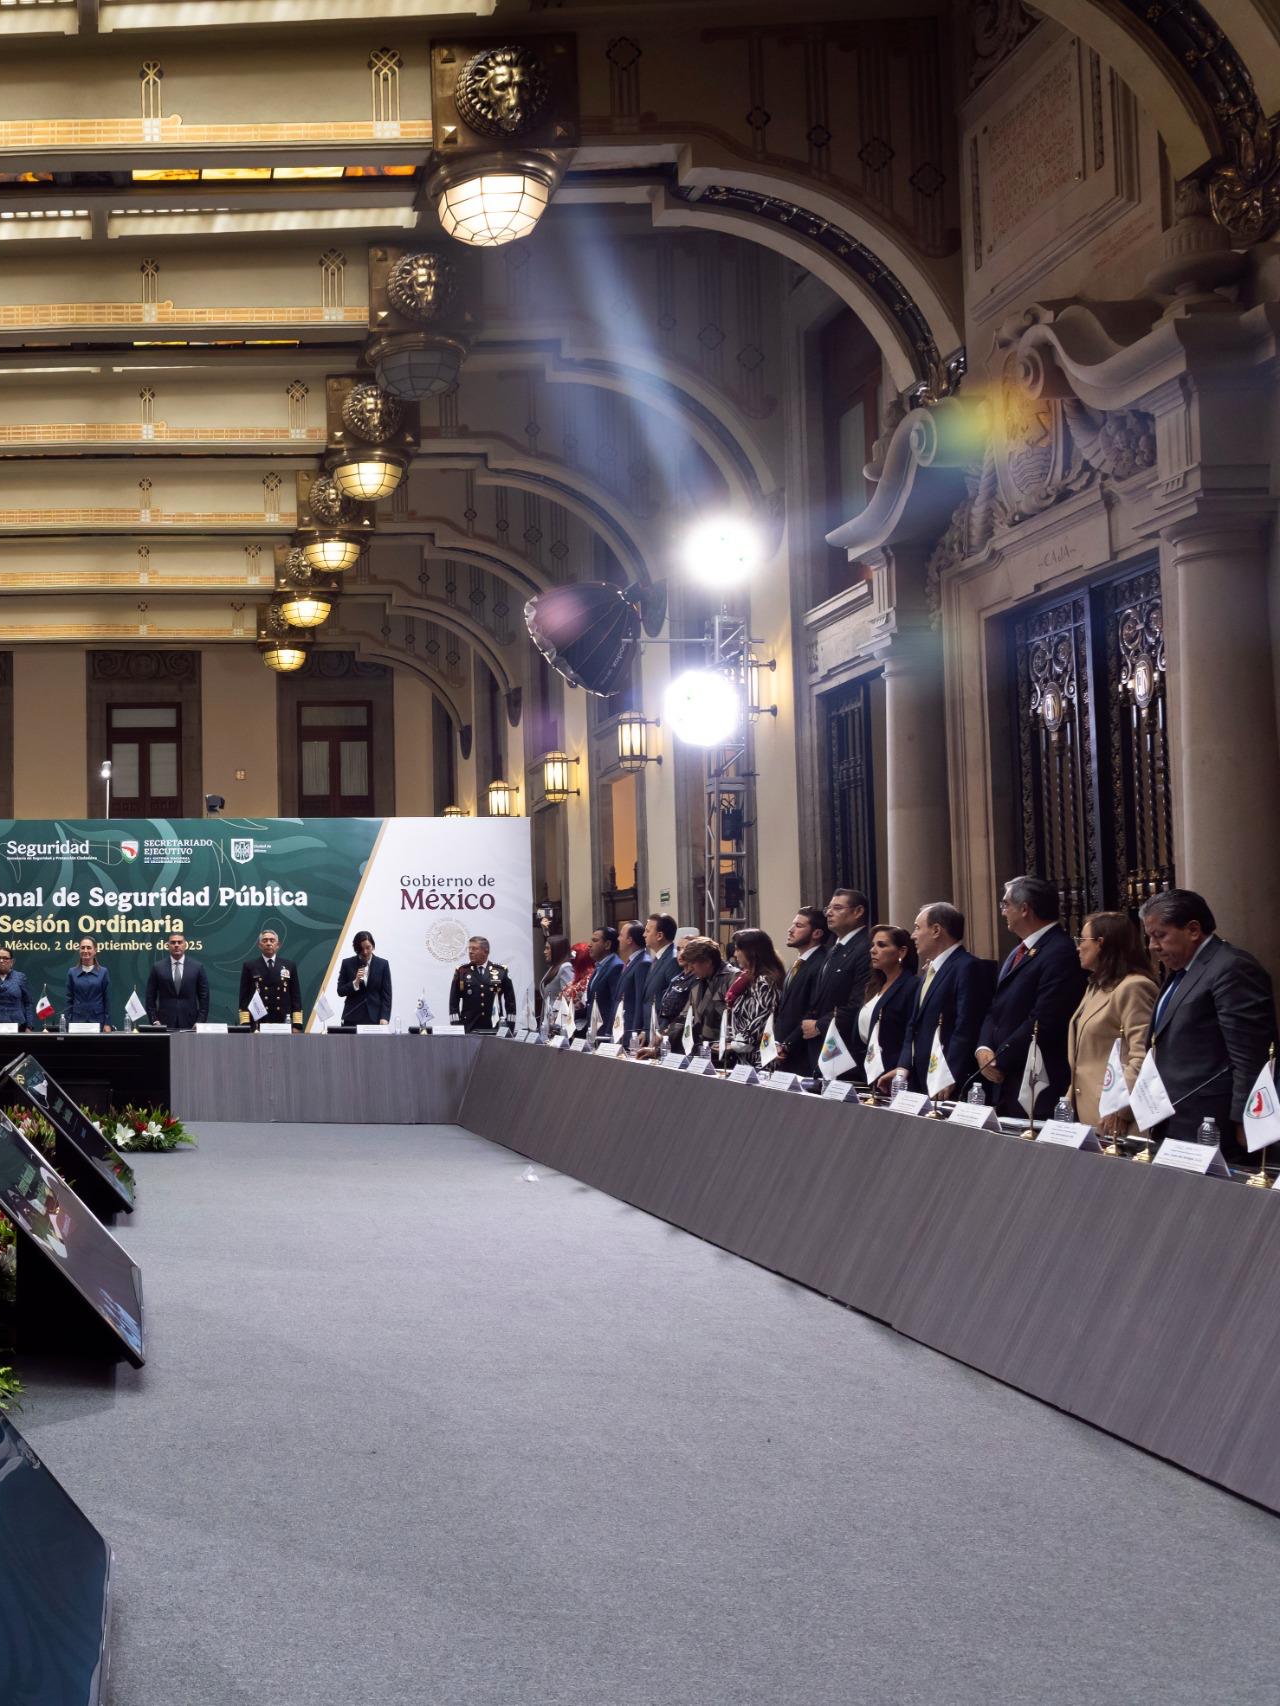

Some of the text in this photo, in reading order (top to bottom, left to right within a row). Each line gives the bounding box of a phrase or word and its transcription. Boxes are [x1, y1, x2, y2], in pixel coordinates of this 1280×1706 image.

[6, 839, 90, 857] Seguridad
[144, 839, 213, 847] SECRETARIADO
[144, 847, 193, 855] EJECUTIVO
[400, 874, 495, 887] Gobierno de
[53, 886, 81, 907] de
[88, 886, 210, 912] Seguridad
[219, 886, 308, 907] Pública
[400, 888, 495, 910] México
[78, 914, 184, 933] Ordinaria
[5, 940, 51, 952] México,
[54, 940, 62, 951] 2
[65, 939, 80, 951] de
[96, 939, 153, 953] ptiembre
[156, 939, 170, 951] de
